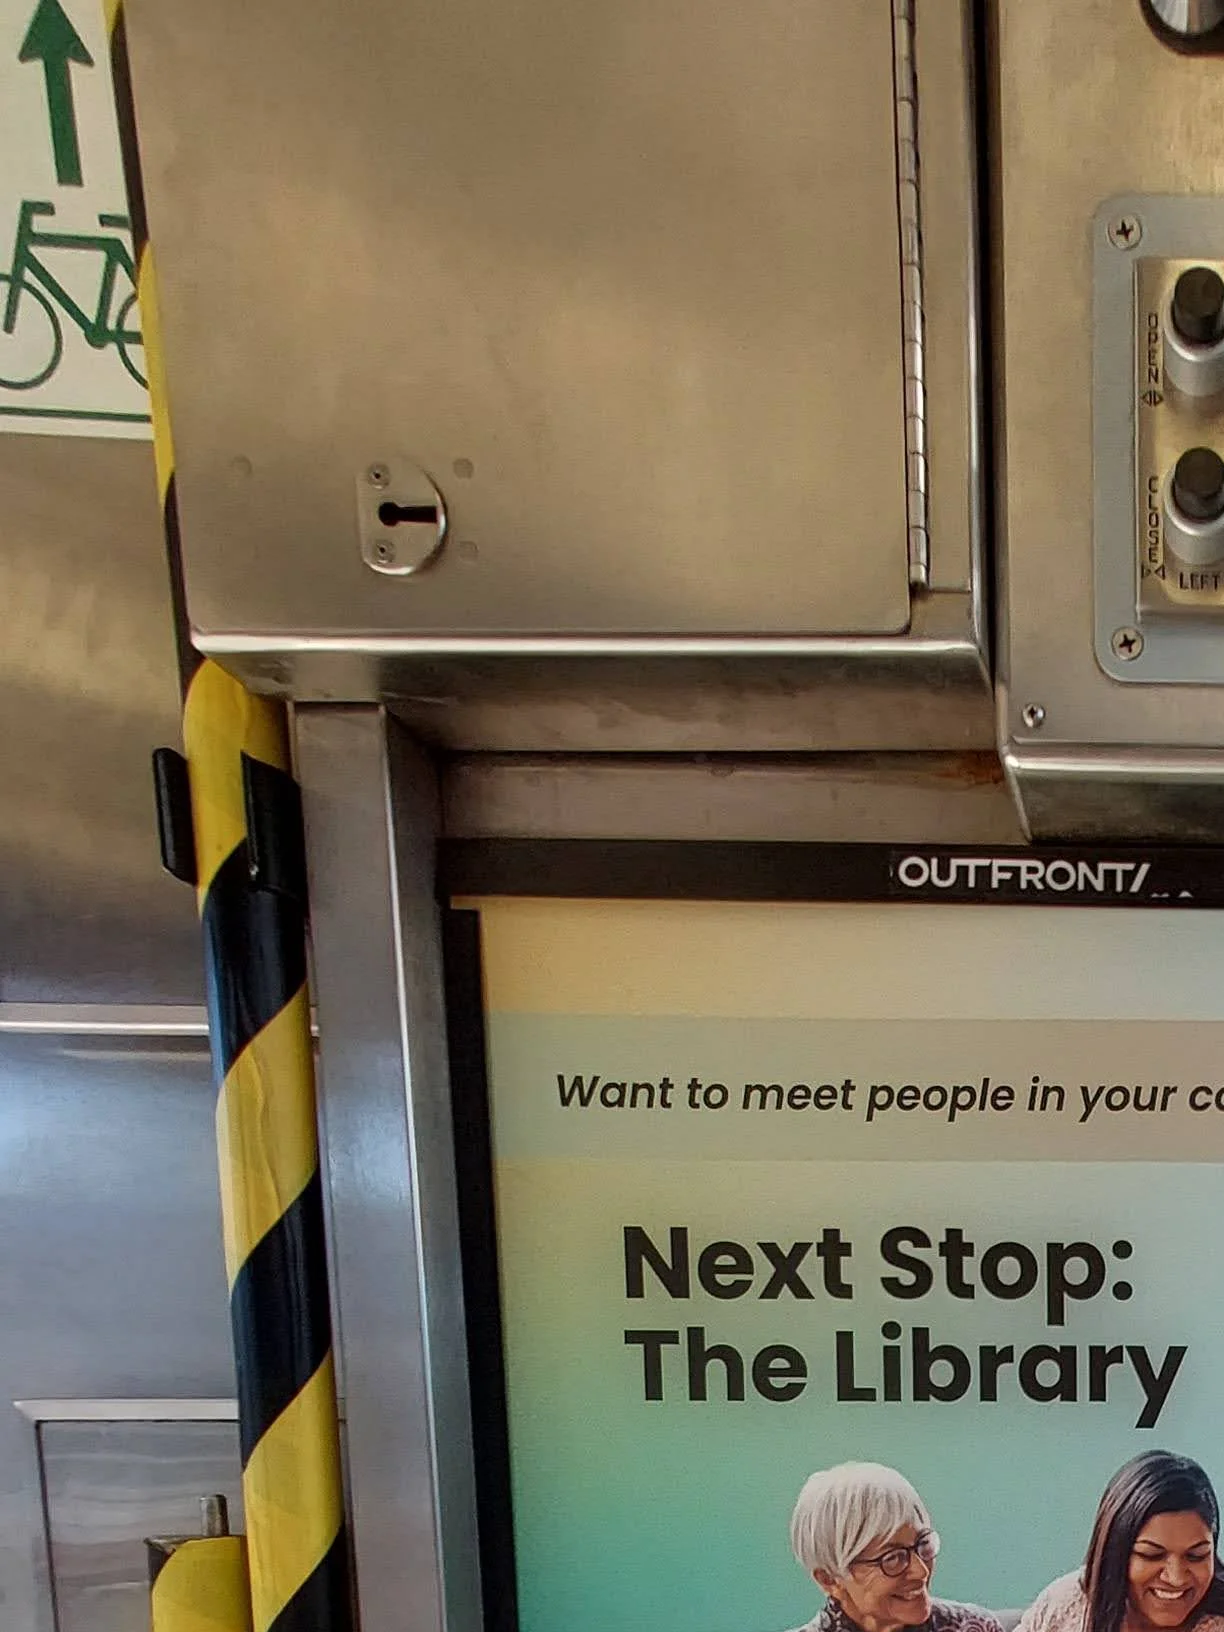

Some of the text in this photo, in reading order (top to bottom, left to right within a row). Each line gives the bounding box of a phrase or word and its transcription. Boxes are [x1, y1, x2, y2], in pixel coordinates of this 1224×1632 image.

[1147, 313, 1159, 384] OPEN
[1148, 476, 1159, 564] CLOSE
[1179, 572, 1221, 592] LEFT
[556, 1074, 673, 1109] Want
[687, 1078, 729, 1110] to
[742, 1079, 856, 1111] meet
[865, 1078, 1016, 1123] people
[1027, 1076, 1065, 1112] in
[1078, 1082, 1178, 1123] your
[623, 1226, 1134, 1326] Next Stop:
[624, 1321, 1188, 1429] The Library
